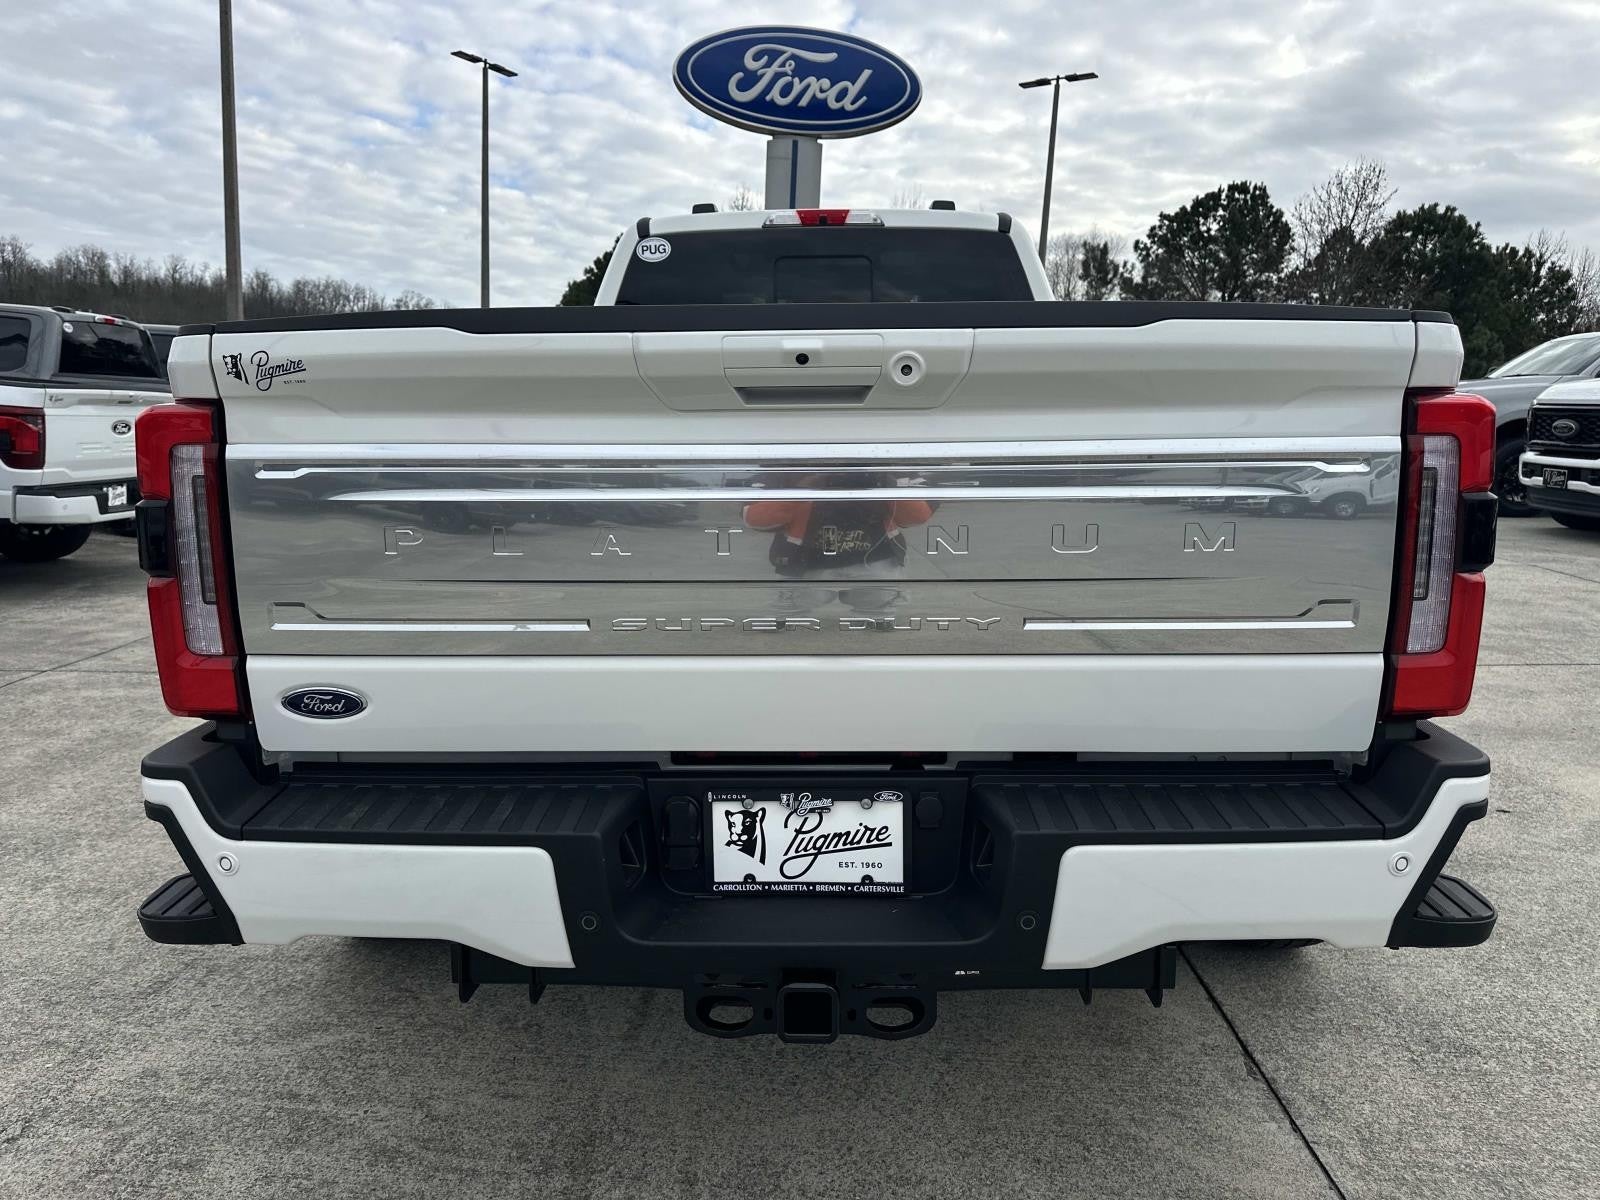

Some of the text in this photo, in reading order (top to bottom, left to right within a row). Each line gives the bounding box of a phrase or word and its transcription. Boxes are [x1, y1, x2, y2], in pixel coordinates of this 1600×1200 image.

[728, 43, 873, 112] Ford
[641, 243, 667, 255] PUG
[250, 350, 306, 391] Pugmire
[384, 522, 1236, 555] PLATINUM
[612, 617, 1001, 632] SUPER DUTY
[301, 694, 345, 712] Ford
[797, 792, 833, 816] Pugmire
[779, 809, 892, 880] Pugmire
[815, 884, 846, 892] BREMEN
[853, 885, 905, 893] CARTERSVILLE
